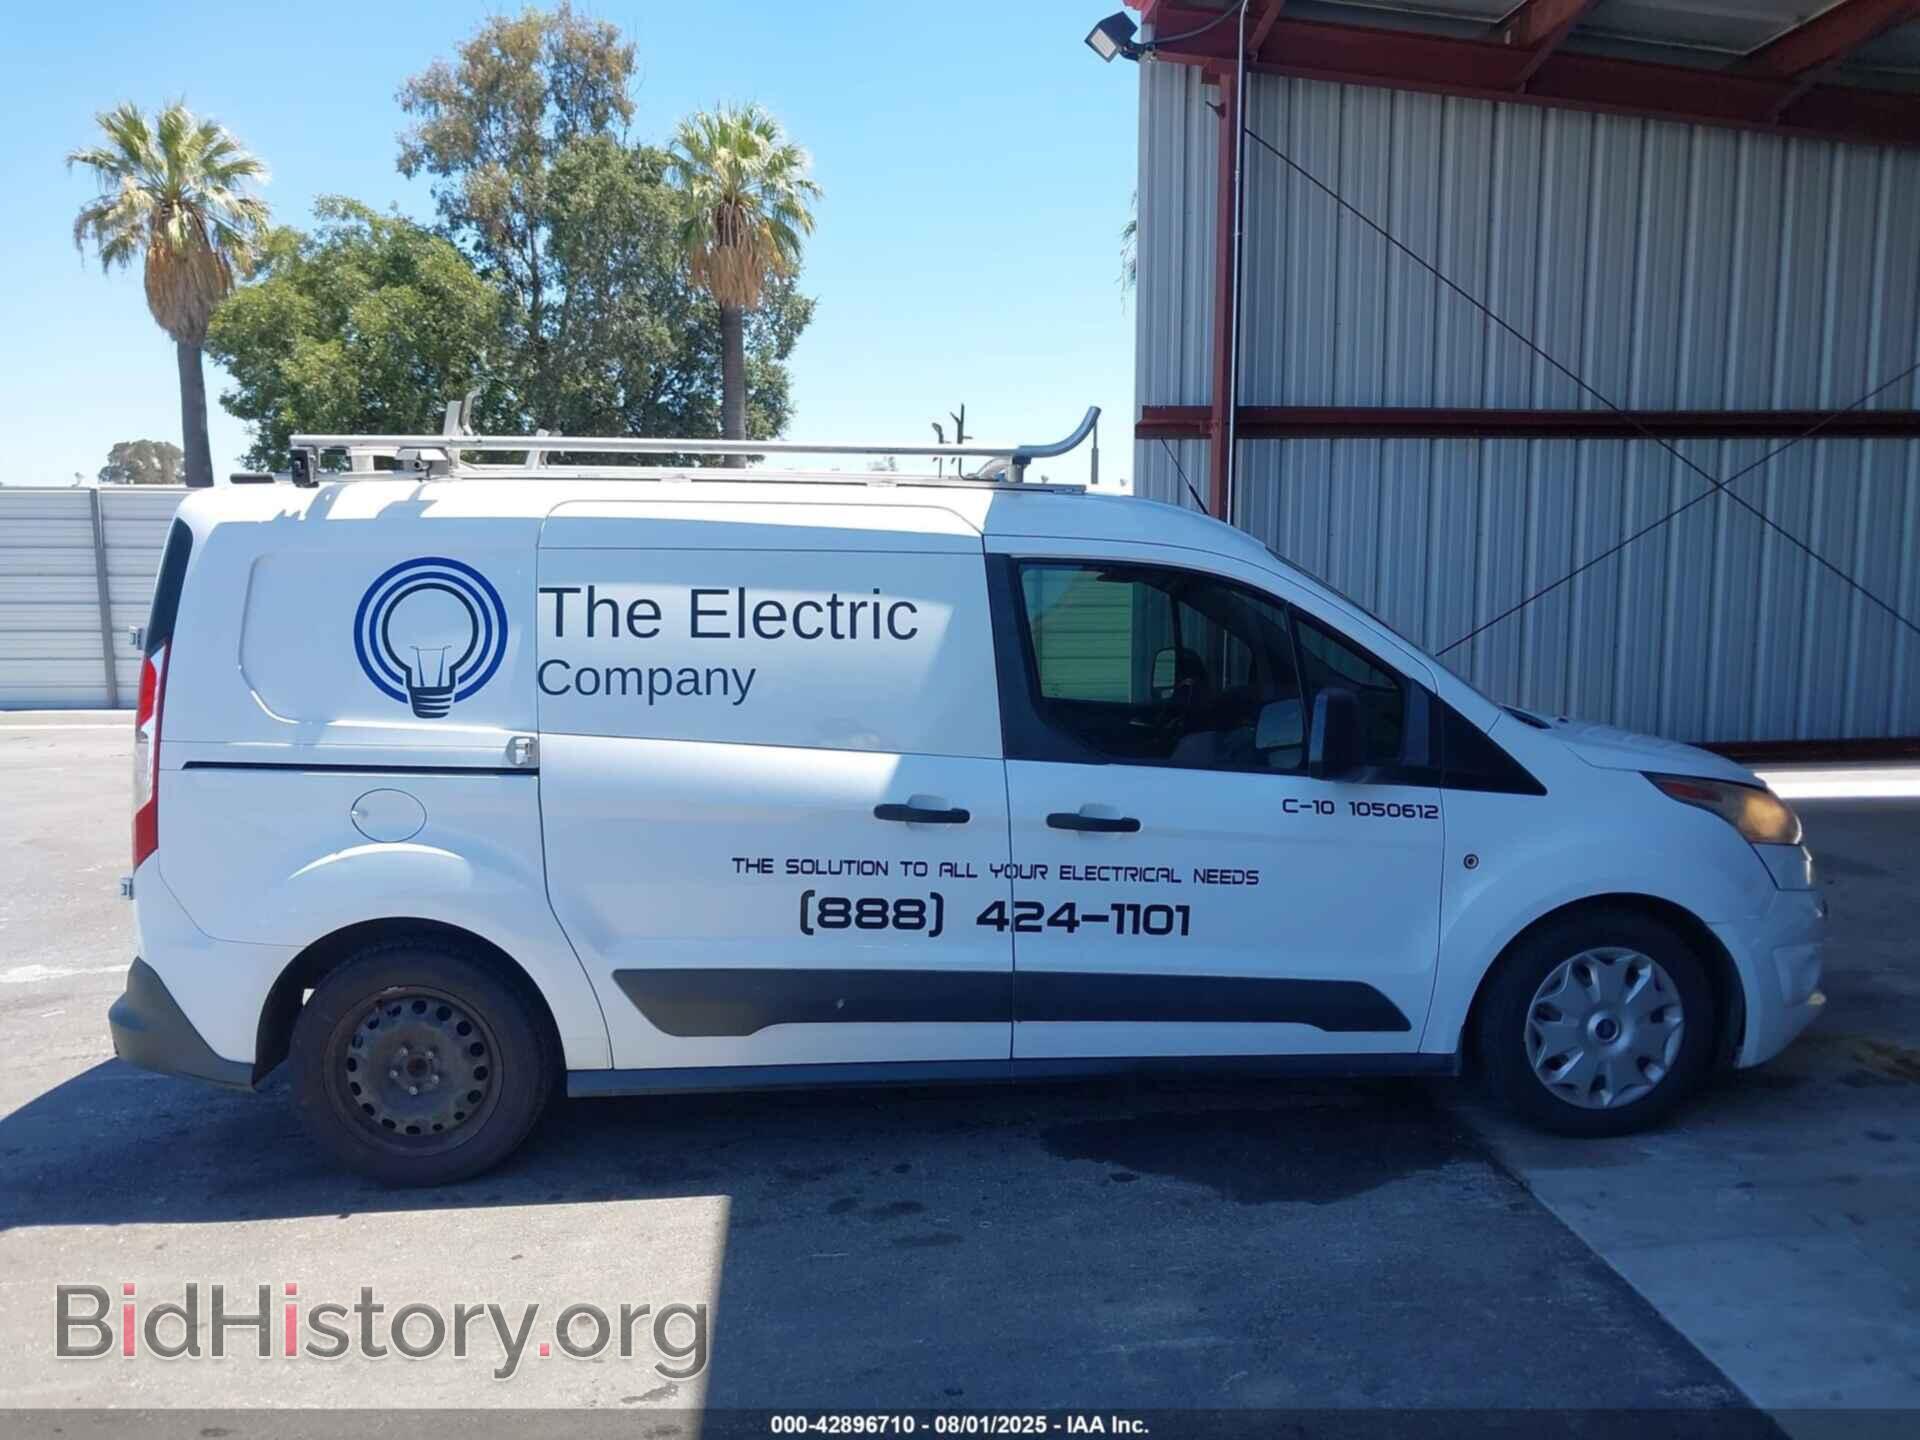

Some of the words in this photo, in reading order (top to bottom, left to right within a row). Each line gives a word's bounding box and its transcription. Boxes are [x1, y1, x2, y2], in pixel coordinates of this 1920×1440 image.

[539, 585, 662, 638] The
[690, 587, 918, 640] Electric
[537, 659, 756, 706] Company
[1282, 799, 1335, 815] C-10
[1348, 801, 1439, 819] 1050612
[732, 857, 774, 875] THE
[785, 858, 889, 877] SOLUTION
[900, 861, 928, 877] TO
[939, 862, 978, 878] ALL
[989, 862, 1048, 881] YOUR
[1060, 865, 1182, 883] ELECTRICAL
[1194, 868, 1260, 885] NEEDS
[799, 890, 944, 937] (888)
[976, 901, 1191, 936] 424-1101
